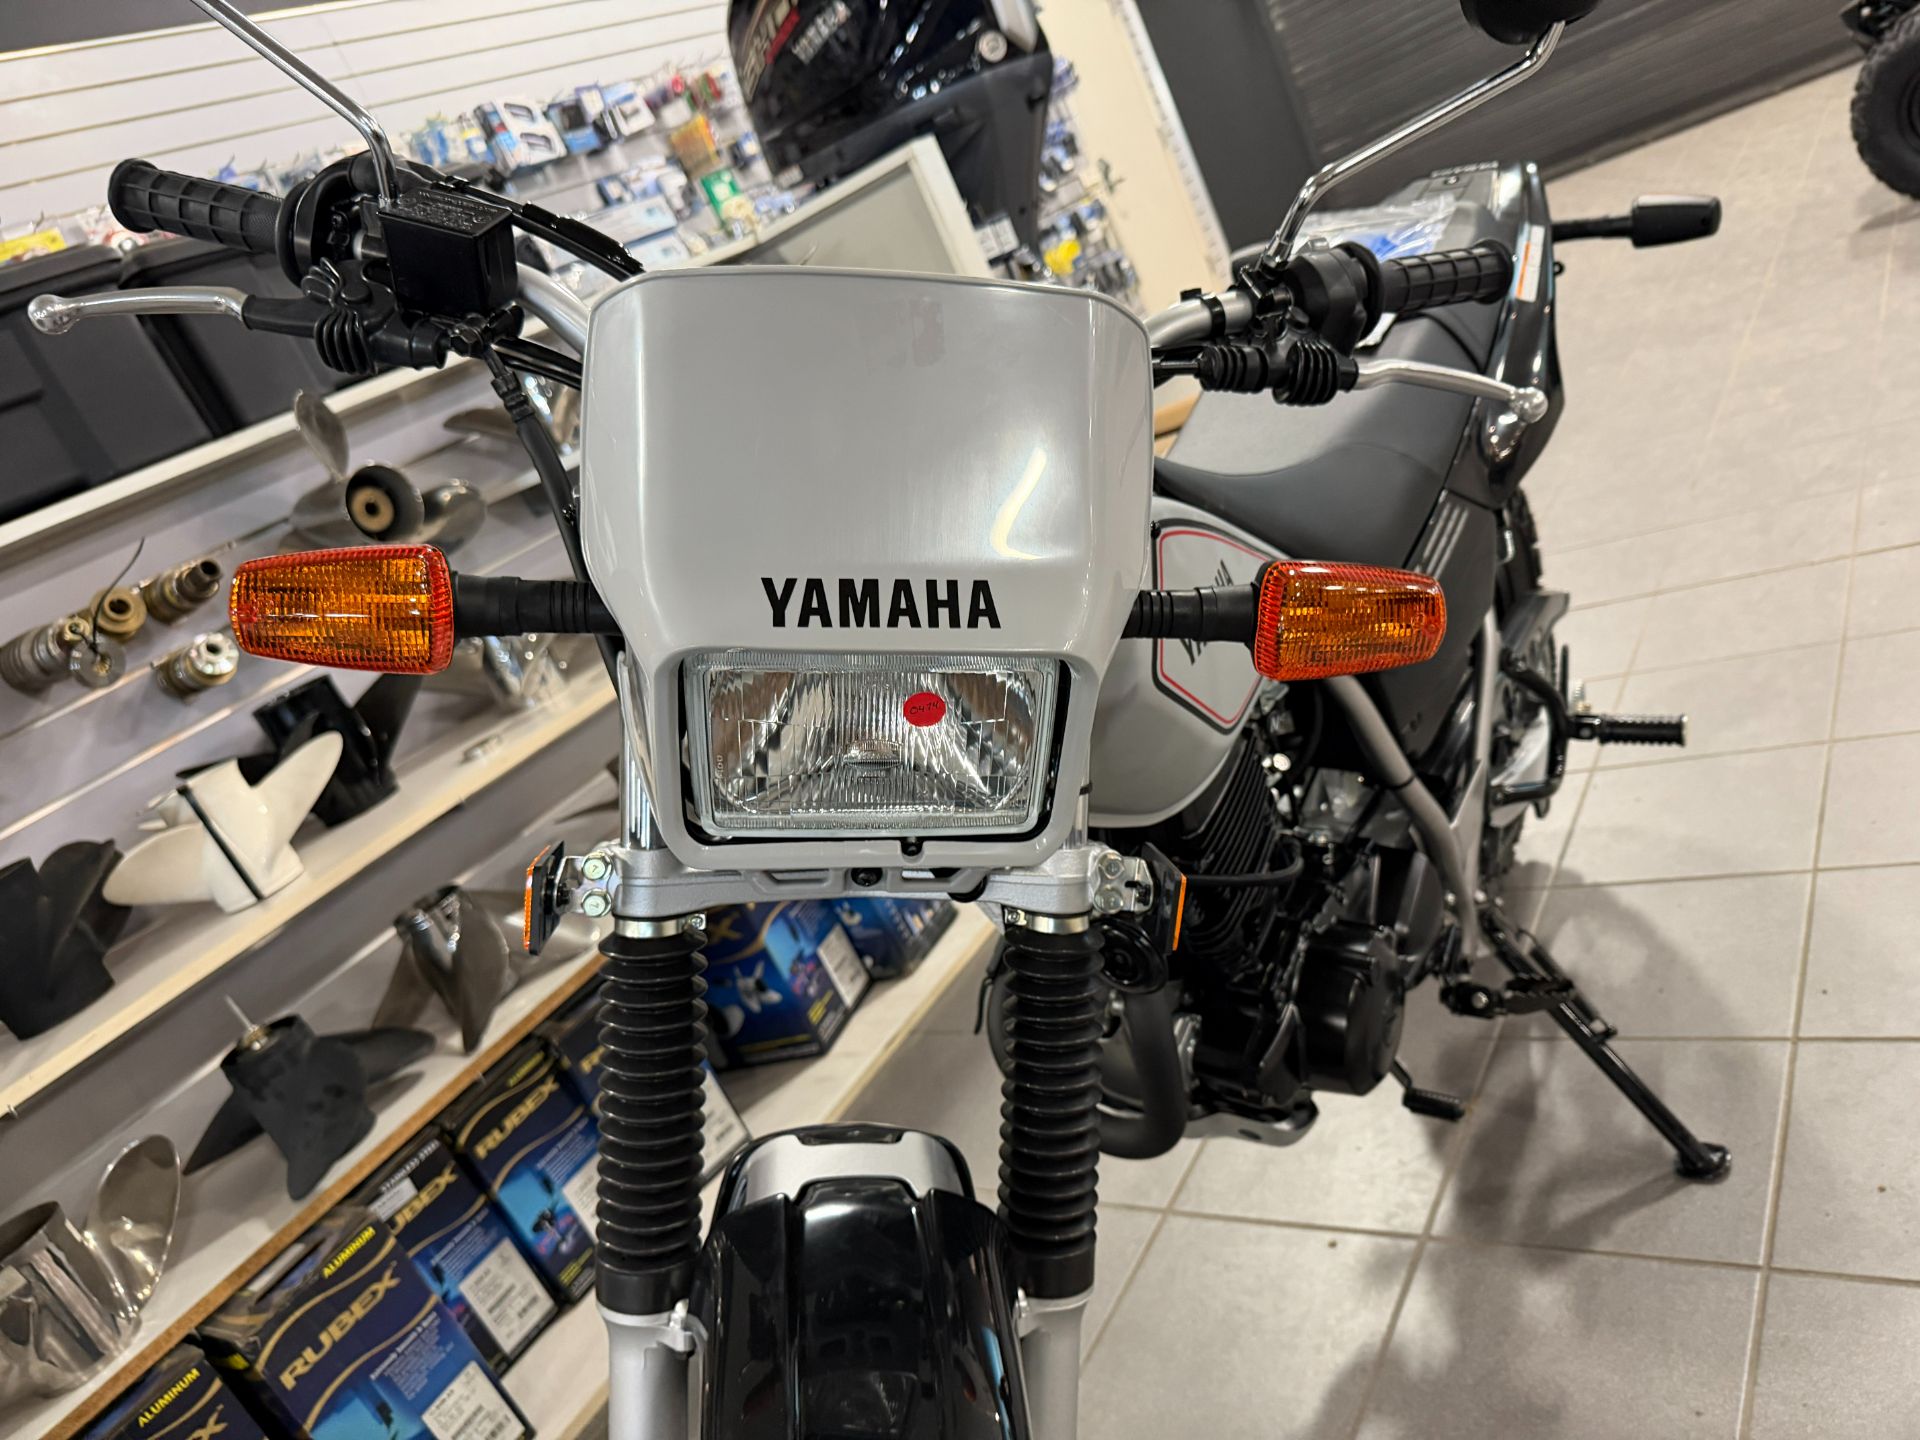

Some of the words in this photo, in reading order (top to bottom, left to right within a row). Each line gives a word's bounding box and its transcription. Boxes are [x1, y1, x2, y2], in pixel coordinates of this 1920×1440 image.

[760, 577, 1002, 628] YAMAHA
[473, 1075, 559, 1160] RUBEX
[391, 1165, 458, 1236] UBEX
[322, 1225, 377, 1279] ALUMINUM
[278, 1268, 400, 1392] RUBEX
[137, 1367, 201, 1429] ALUMINUM
